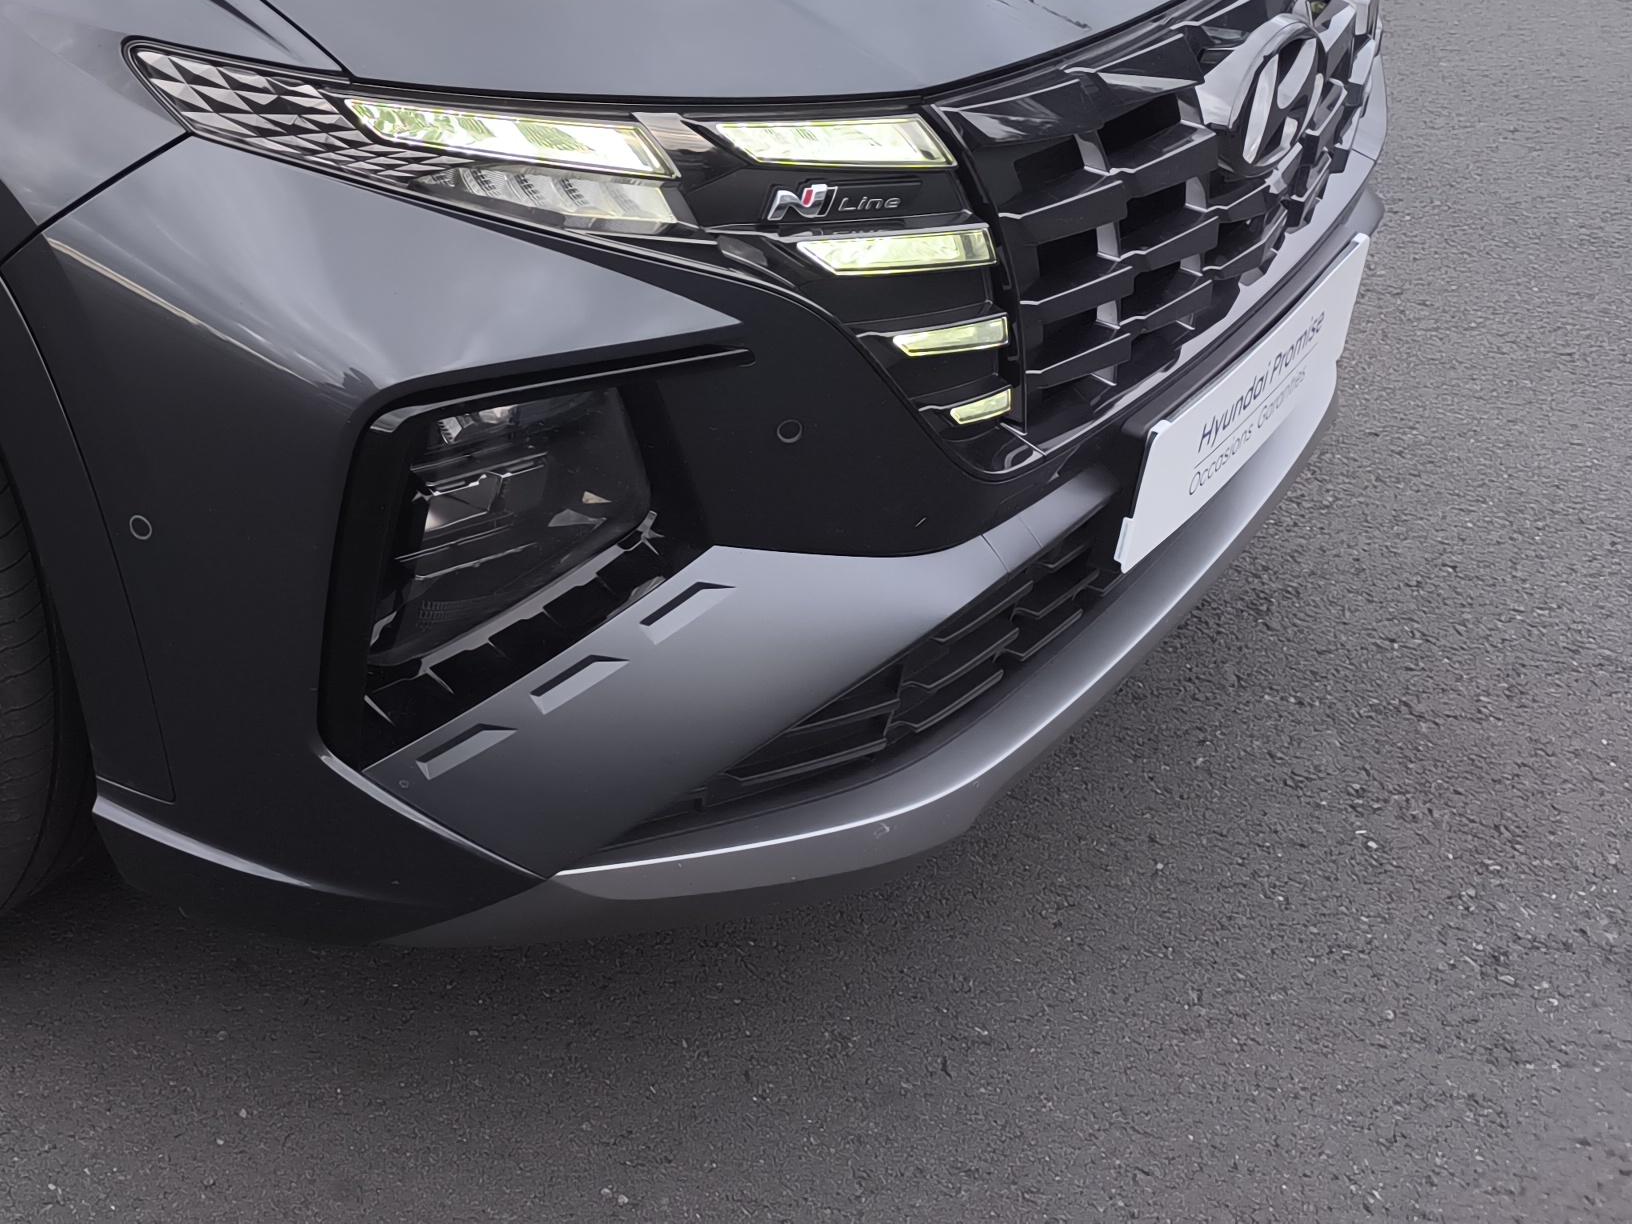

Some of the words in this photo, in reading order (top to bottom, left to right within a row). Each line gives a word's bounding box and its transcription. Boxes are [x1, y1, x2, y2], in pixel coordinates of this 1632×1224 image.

[837, 195, 902, 213] Line
[1198, 360, 1272, 453] Hyundai
[1269, 311, 1325, 384] Promise
[1188, 422, 1255, 496] Occasions
